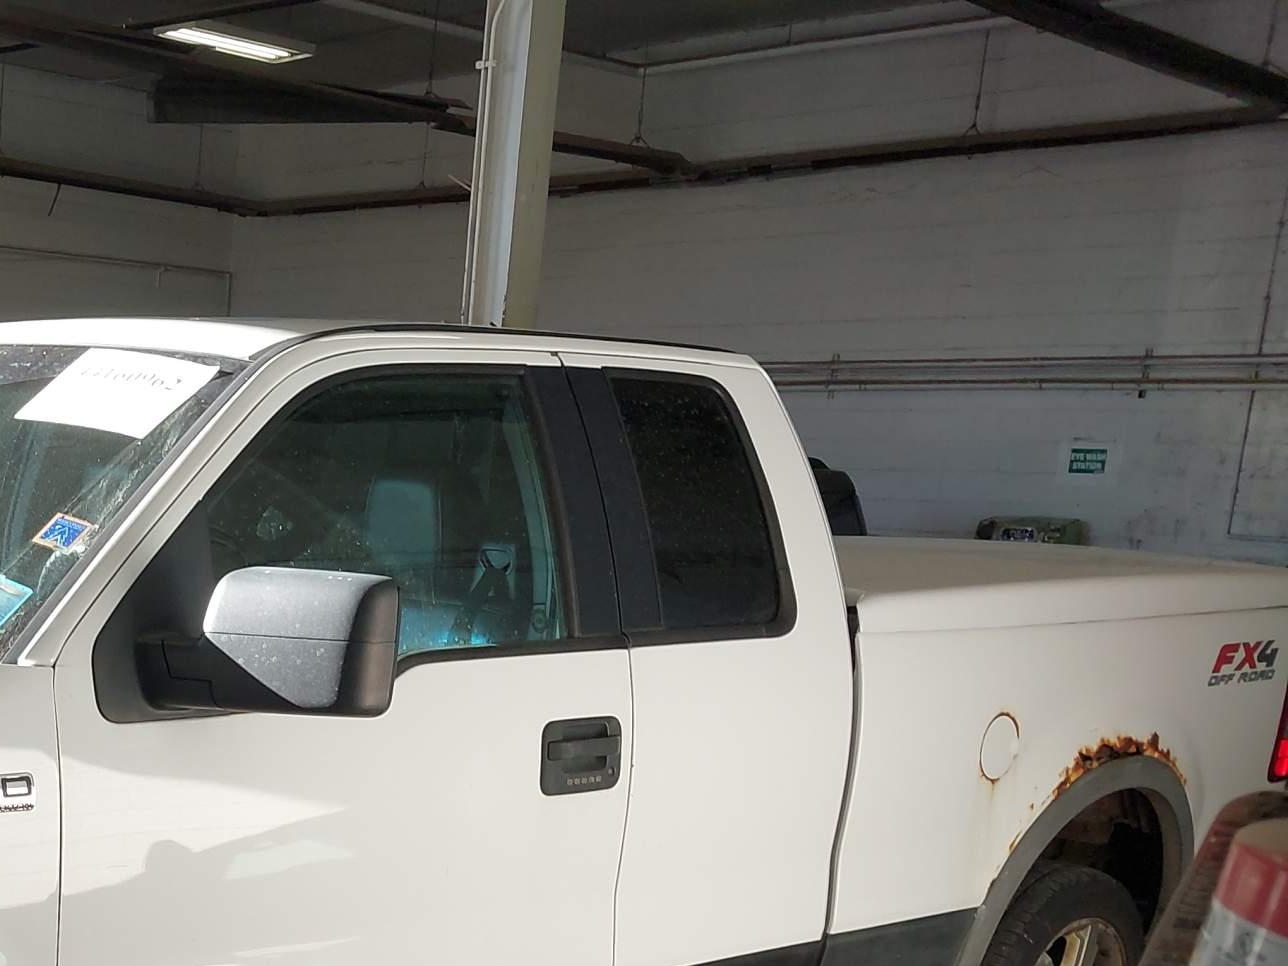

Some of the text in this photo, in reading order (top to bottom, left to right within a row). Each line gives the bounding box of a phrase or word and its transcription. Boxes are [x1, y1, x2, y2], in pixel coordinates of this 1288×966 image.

[1212, 640, 1279, 674] FX4
[1208, 668, 1275, 687] OFF ROAD
